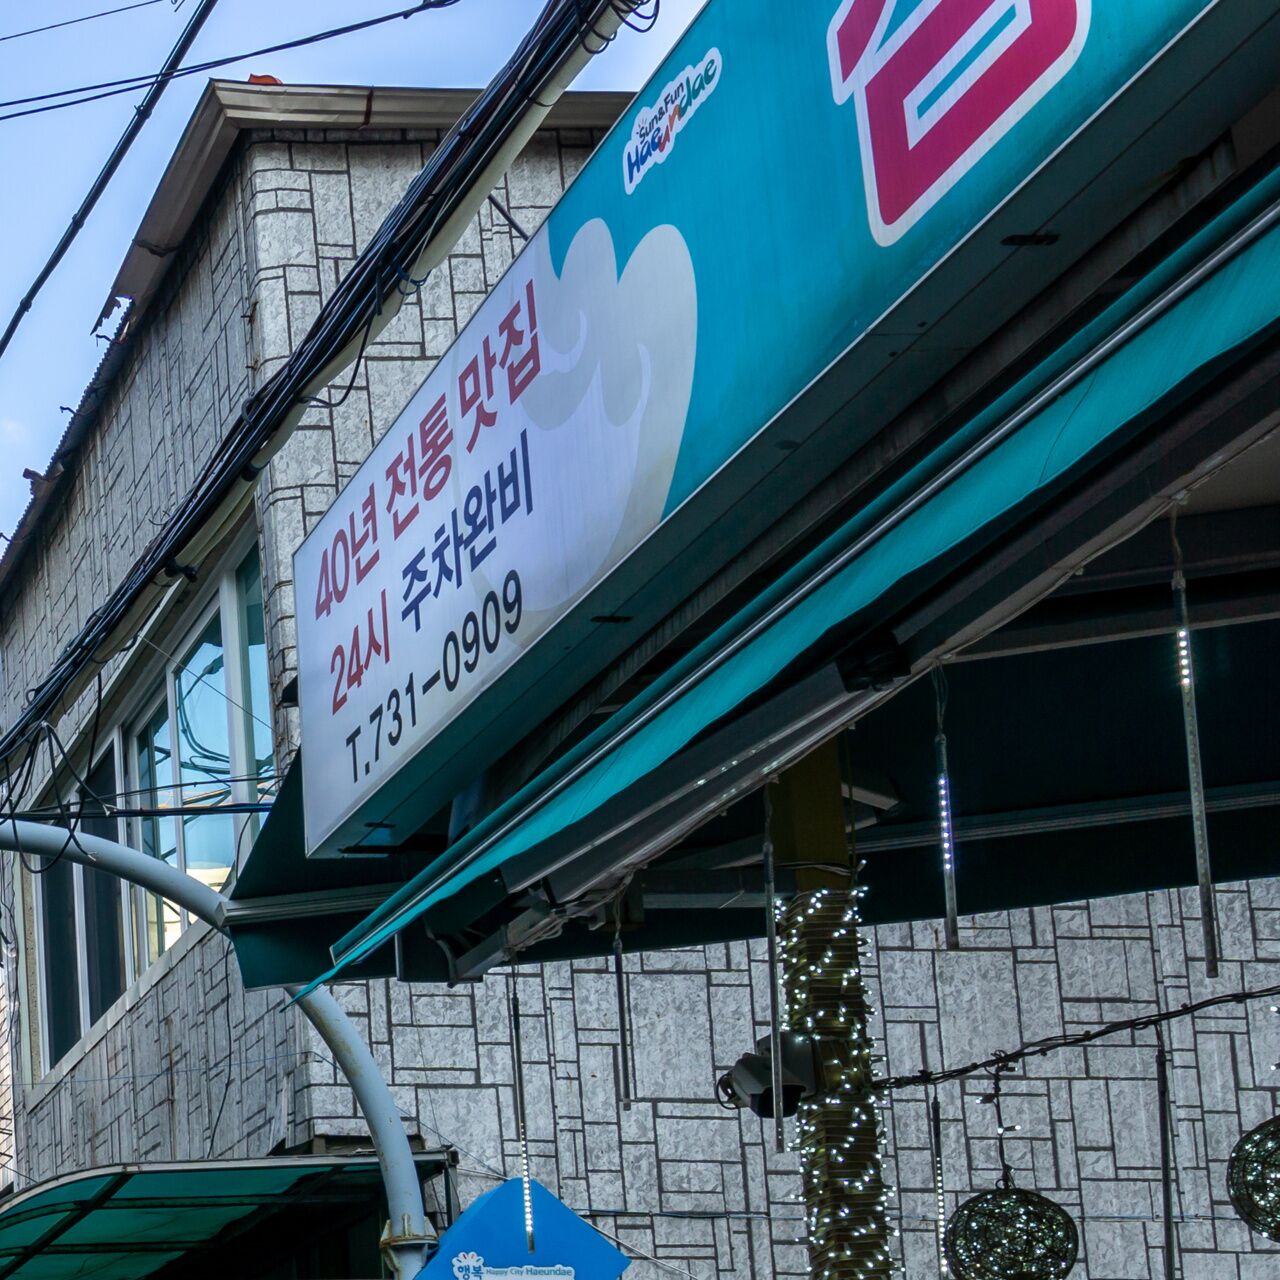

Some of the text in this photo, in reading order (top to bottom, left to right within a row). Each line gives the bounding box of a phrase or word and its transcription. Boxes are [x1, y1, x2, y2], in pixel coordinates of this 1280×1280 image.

[626, 56, 718, 184] Haeundae
[313, 278, 542, 620] 40년 전통 맛집
[330, 429, 534, 716] 24시 주차완비
[344, 567, 523, 783] T.731-0909
